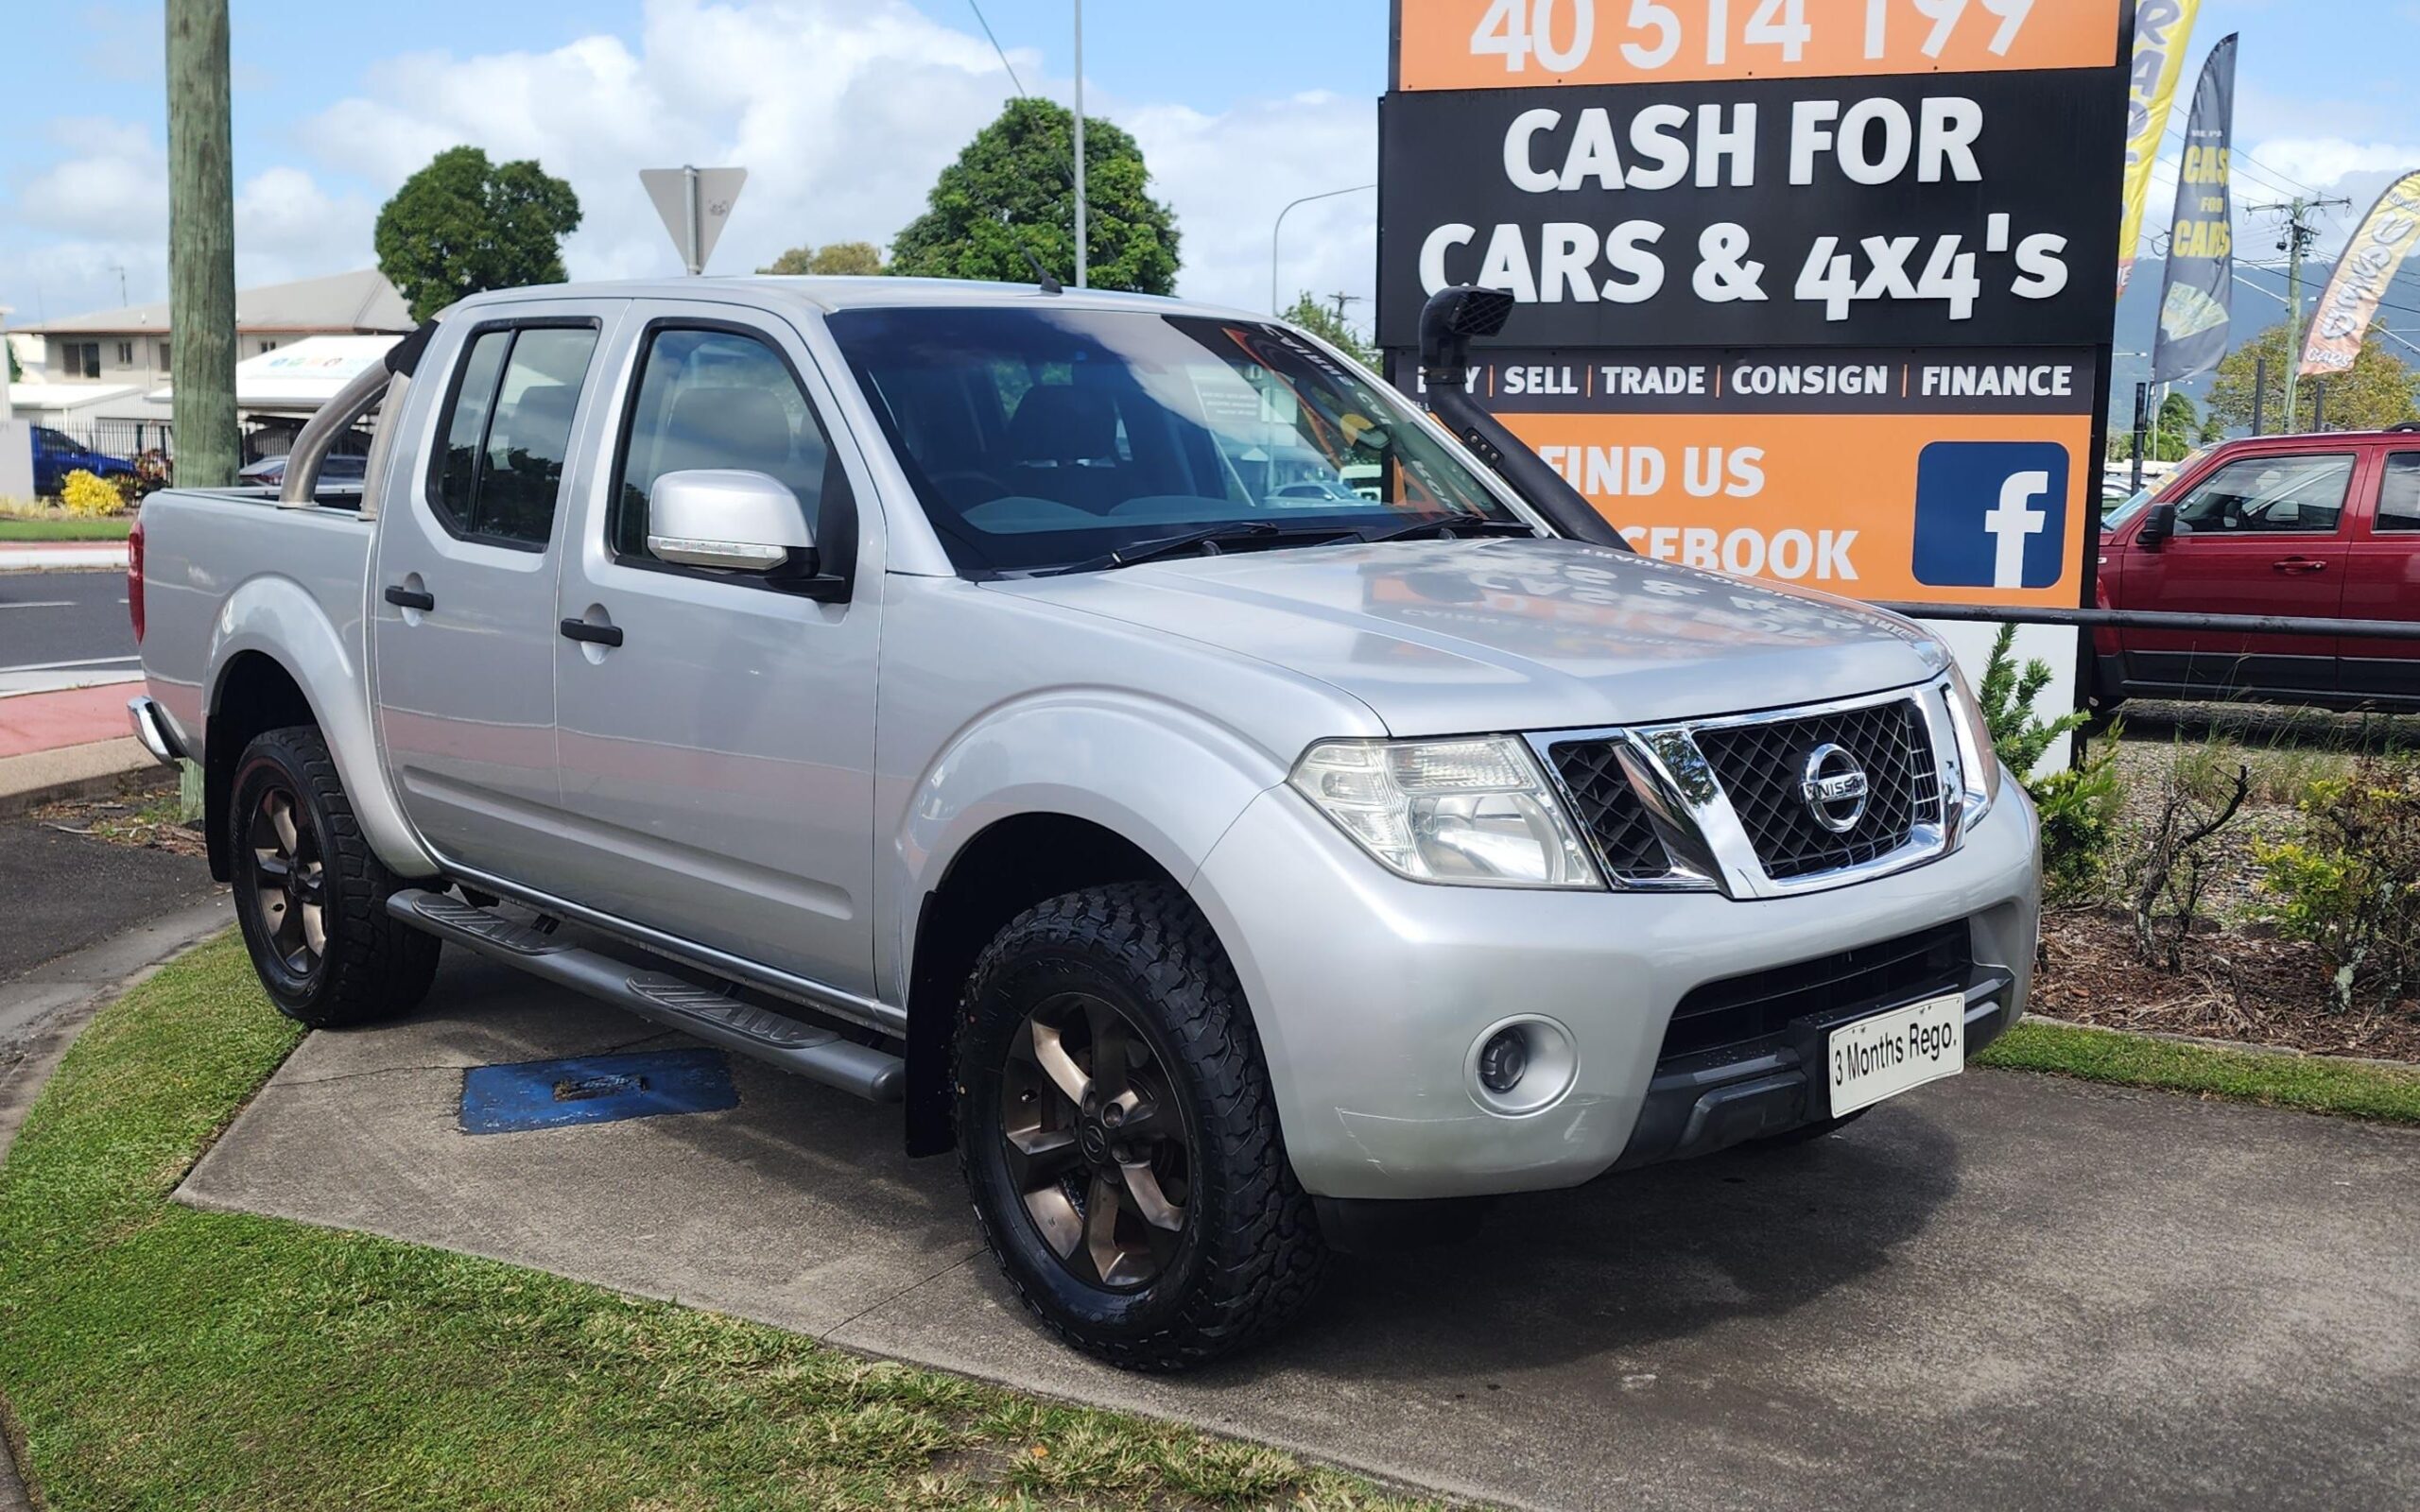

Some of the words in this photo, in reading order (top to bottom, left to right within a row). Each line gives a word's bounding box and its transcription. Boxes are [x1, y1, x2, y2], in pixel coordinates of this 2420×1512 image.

[1470, 0, 1595, 73] 40
[1619, 0, 1812, 70] 514
[1503, 102, 1757, 192] CASH
[1789, 96, 1983, 185] FOR
[1419, 219, 1666, 303] CARS
[1692, 222, 1769, 302] &
[1503, 366, 1579, 394] SELL
[1600, 366, 1705, 394] TRADE
[1731, 365, 1888, 395] CONSIGN
[1921, 365, 2072, 395] FINANCE
[1537, 445, 1666, 496] FIND
[1683, 446, 1765, 498] US
[1818, 775, 1866, 798] NISSAN
[1835, 1049, 1843, 1087] 3
[1847, 1031, 1904, 1081] Months
[1910, 1022, 1957, 1061] Rego.
